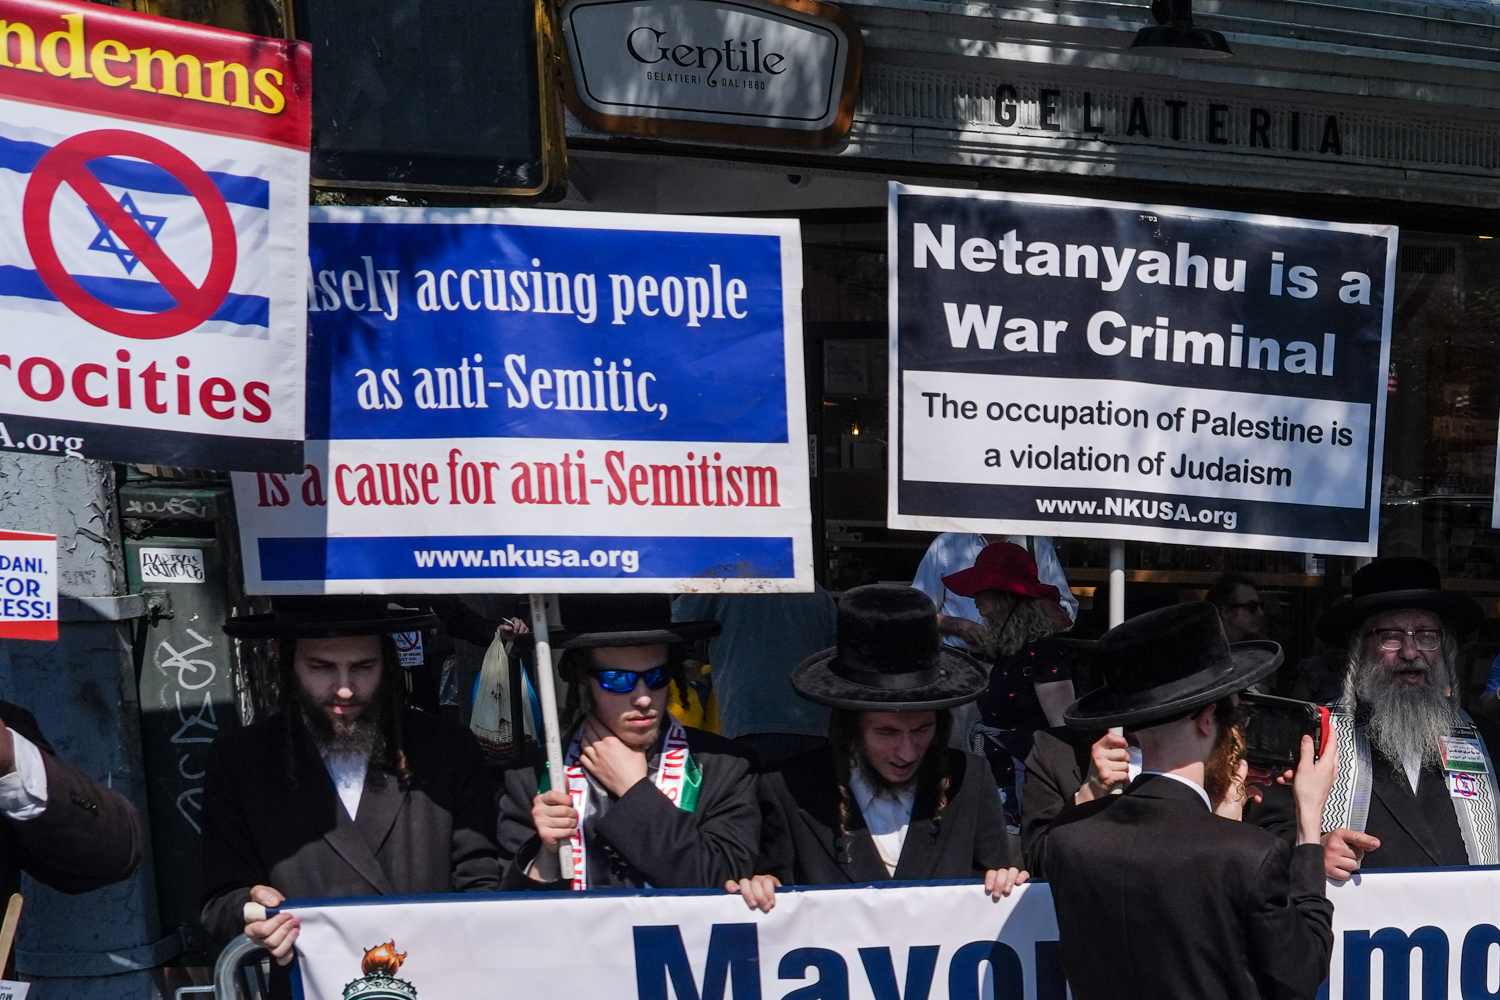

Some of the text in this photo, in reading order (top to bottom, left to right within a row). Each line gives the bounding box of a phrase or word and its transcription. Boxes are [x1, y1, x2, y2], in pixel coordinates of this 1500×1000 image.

[627, 26, 787, 87] Gentile
[647, 71, 765, 90] GELATIERI DAL 1880
[994, 84, 1343, 155] GELATERIA
[308, 256, 749, 328] lsely accusing people
[912, 222, 1372, 306] Netanyahu is a
[943, 302, 1335, 377] War Criminal
[355, 353, 668, 421] as anti-Semitic,
[921, 392, 1354, 448] The occupation of Palestine is
[301, 463, 327, 507] a
[335, 462, 440, 506] cause
[447, 448, 500, 505] for
[510, 452, 780, 509] anti-Semitism
[983, 443, 1293, 488] a violation of Judaism
[1035, 497, 1239, 530] www.NKUSA.org
[413, 544, 640, 574] www.nkusa.org
[0, 598, 51, 619] ESS!
[660, 725, 688, 802] STINE
